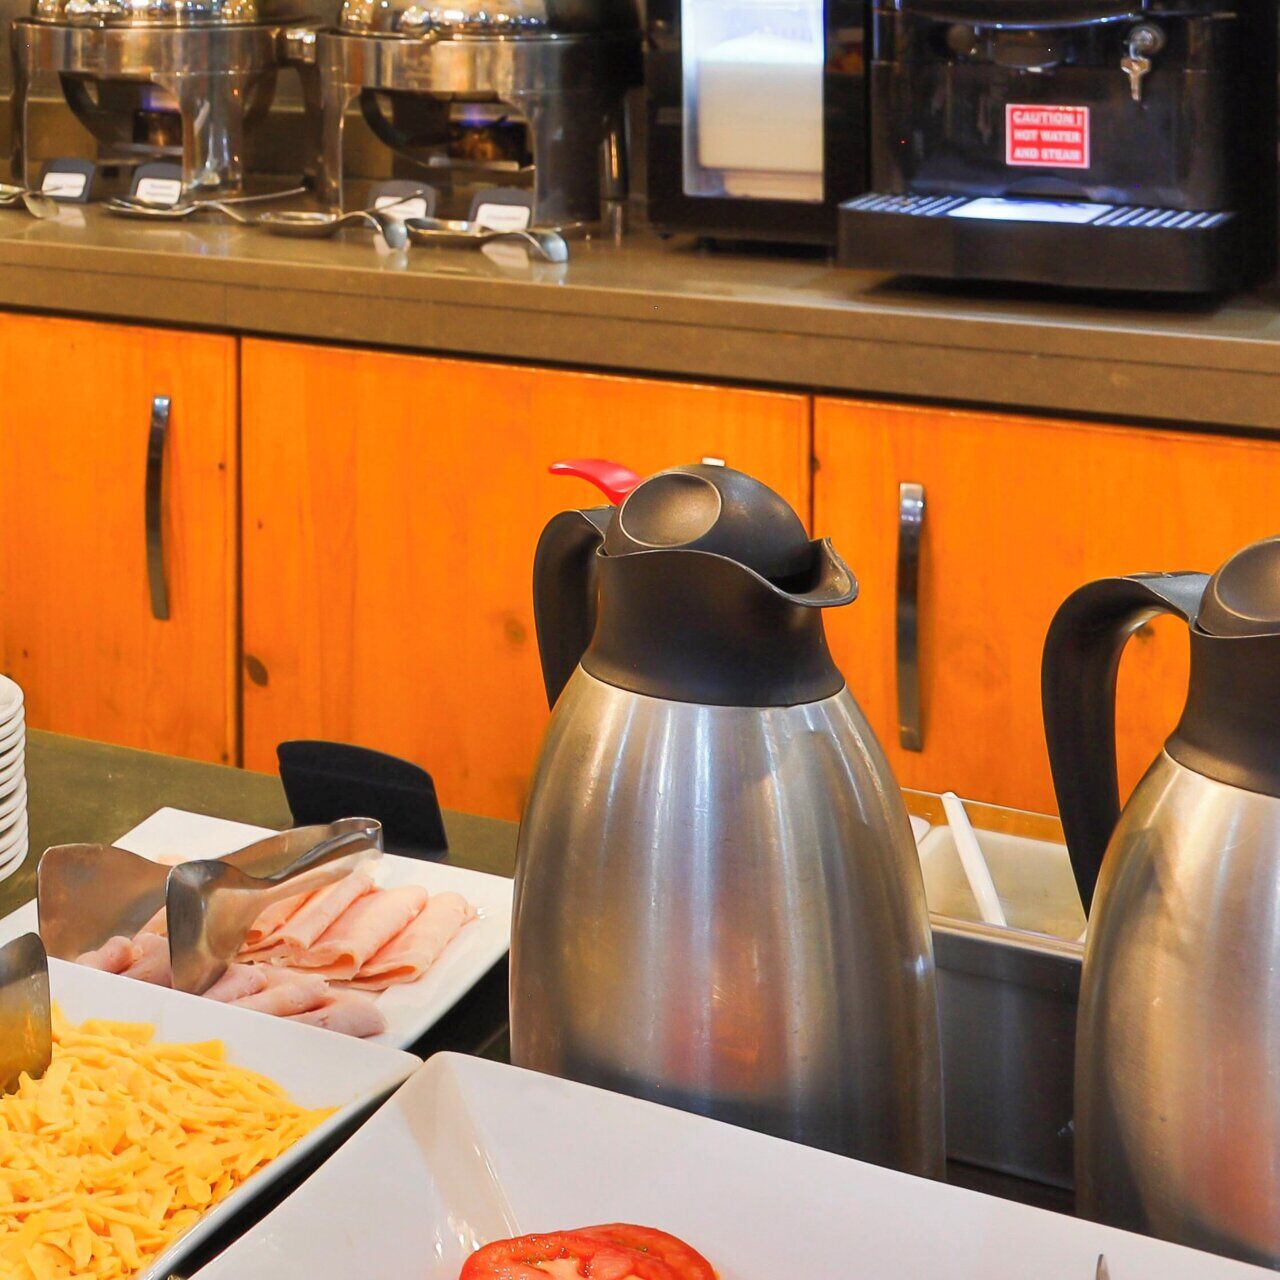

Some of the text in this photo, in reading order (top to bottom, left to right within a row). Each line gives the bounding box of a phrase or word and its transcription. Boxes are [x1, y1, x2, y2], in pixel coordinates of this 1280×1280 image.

[1012, 111, 1074, 126] CAUTION
[1013, 129, 1081, 143] HOT WATER
[1013, 147, 1081, 161] AND STEAM
